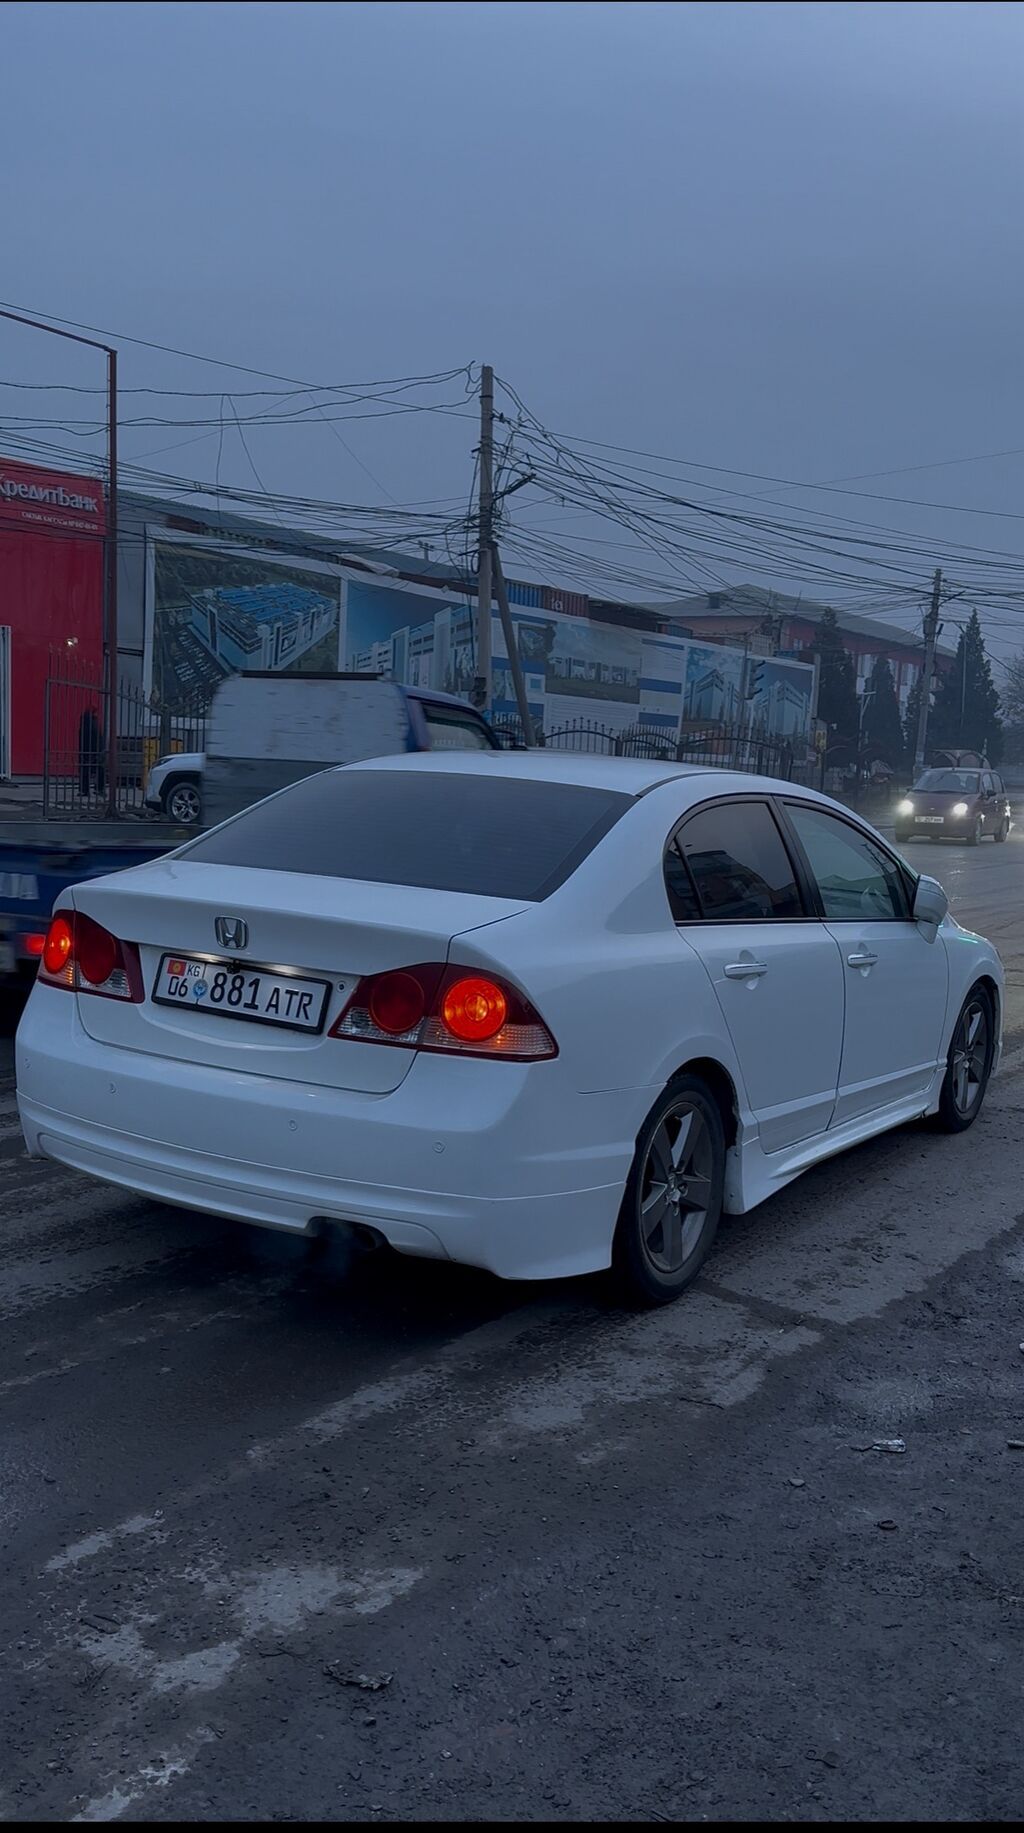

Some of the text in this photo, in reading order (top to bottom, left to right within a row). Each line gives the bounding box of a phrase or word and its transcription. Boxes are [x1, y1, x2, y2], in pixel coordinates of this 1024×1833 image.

[186, 964, 201, 977] KG
[167, 972, 314, 1020] 06 881 ATR
